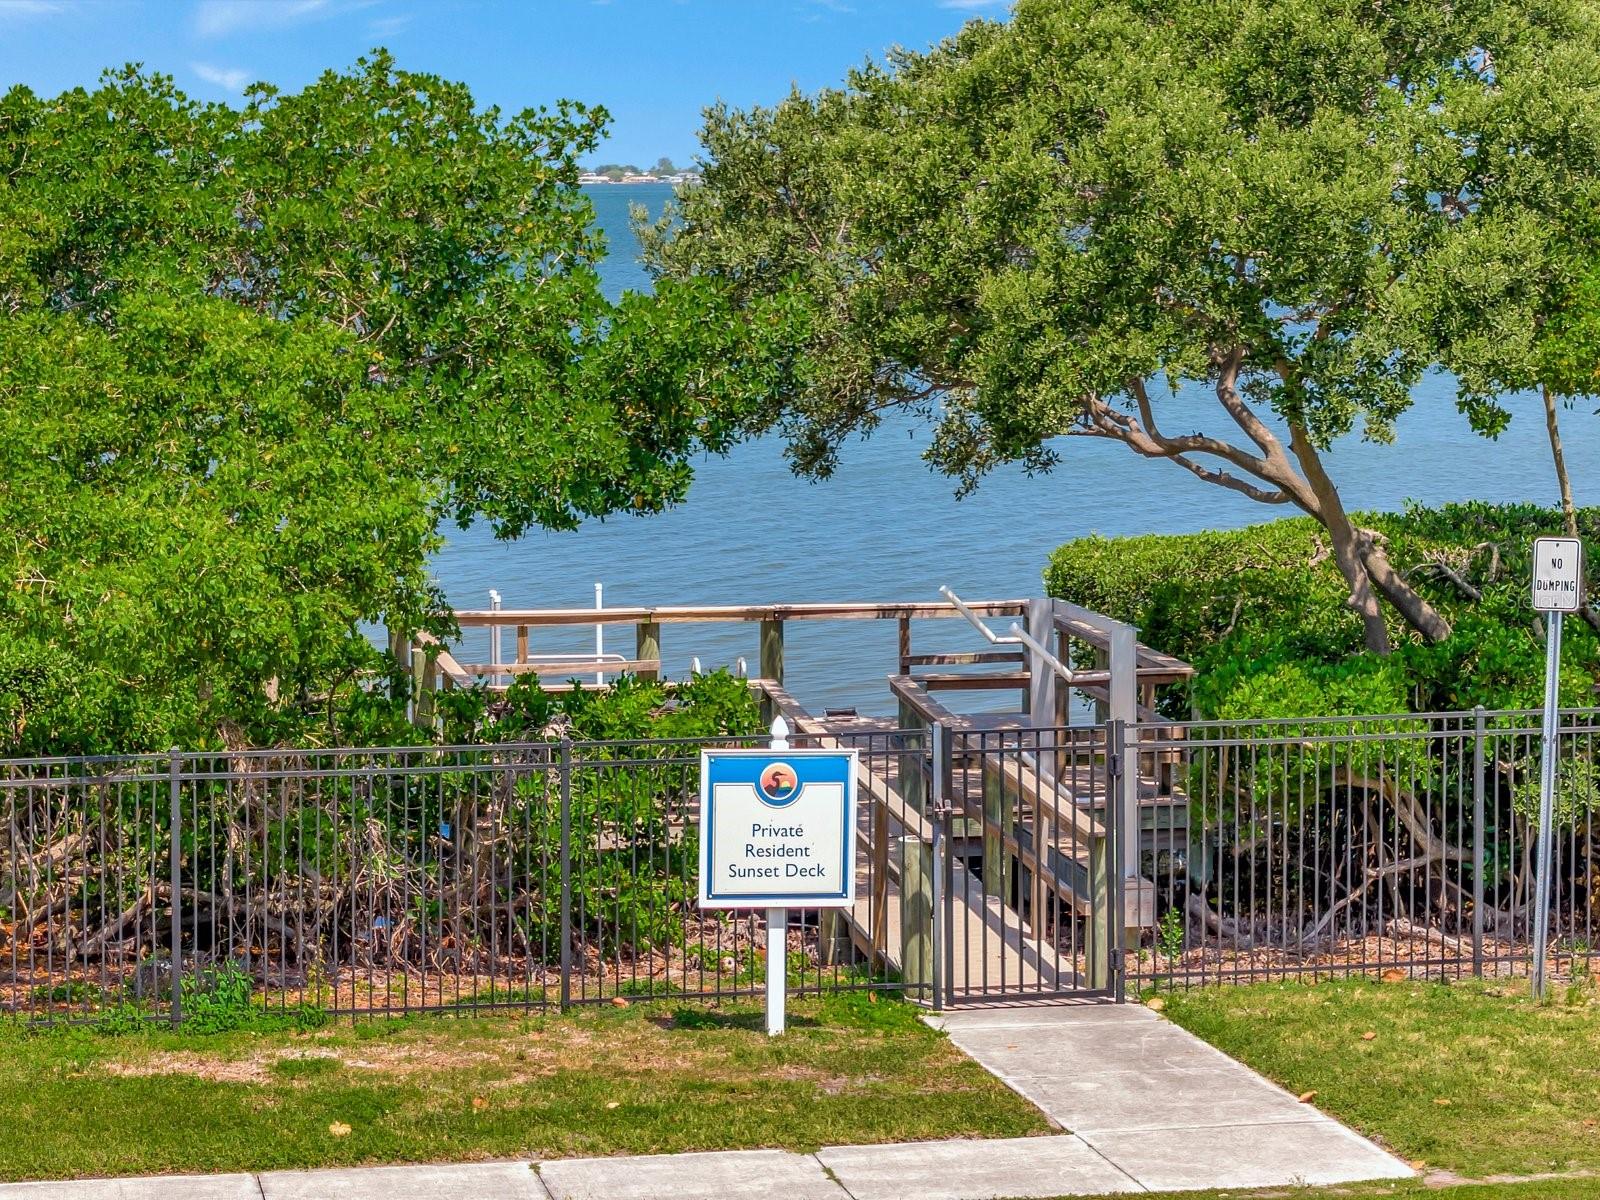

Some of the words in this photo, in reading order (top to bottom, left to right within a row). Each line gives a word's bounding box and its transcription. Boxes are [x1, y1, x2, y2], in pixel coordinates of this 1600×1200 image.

[1551, 558, 1563, 569] NO
[1536, 579, 1575, 592] DUMPING
[751, 823, 804, 838] Private
[745, 843, 811, 858] Resident
[728, 863, 780, 878] Sunset
[785, 863, 826, 878] Deck
